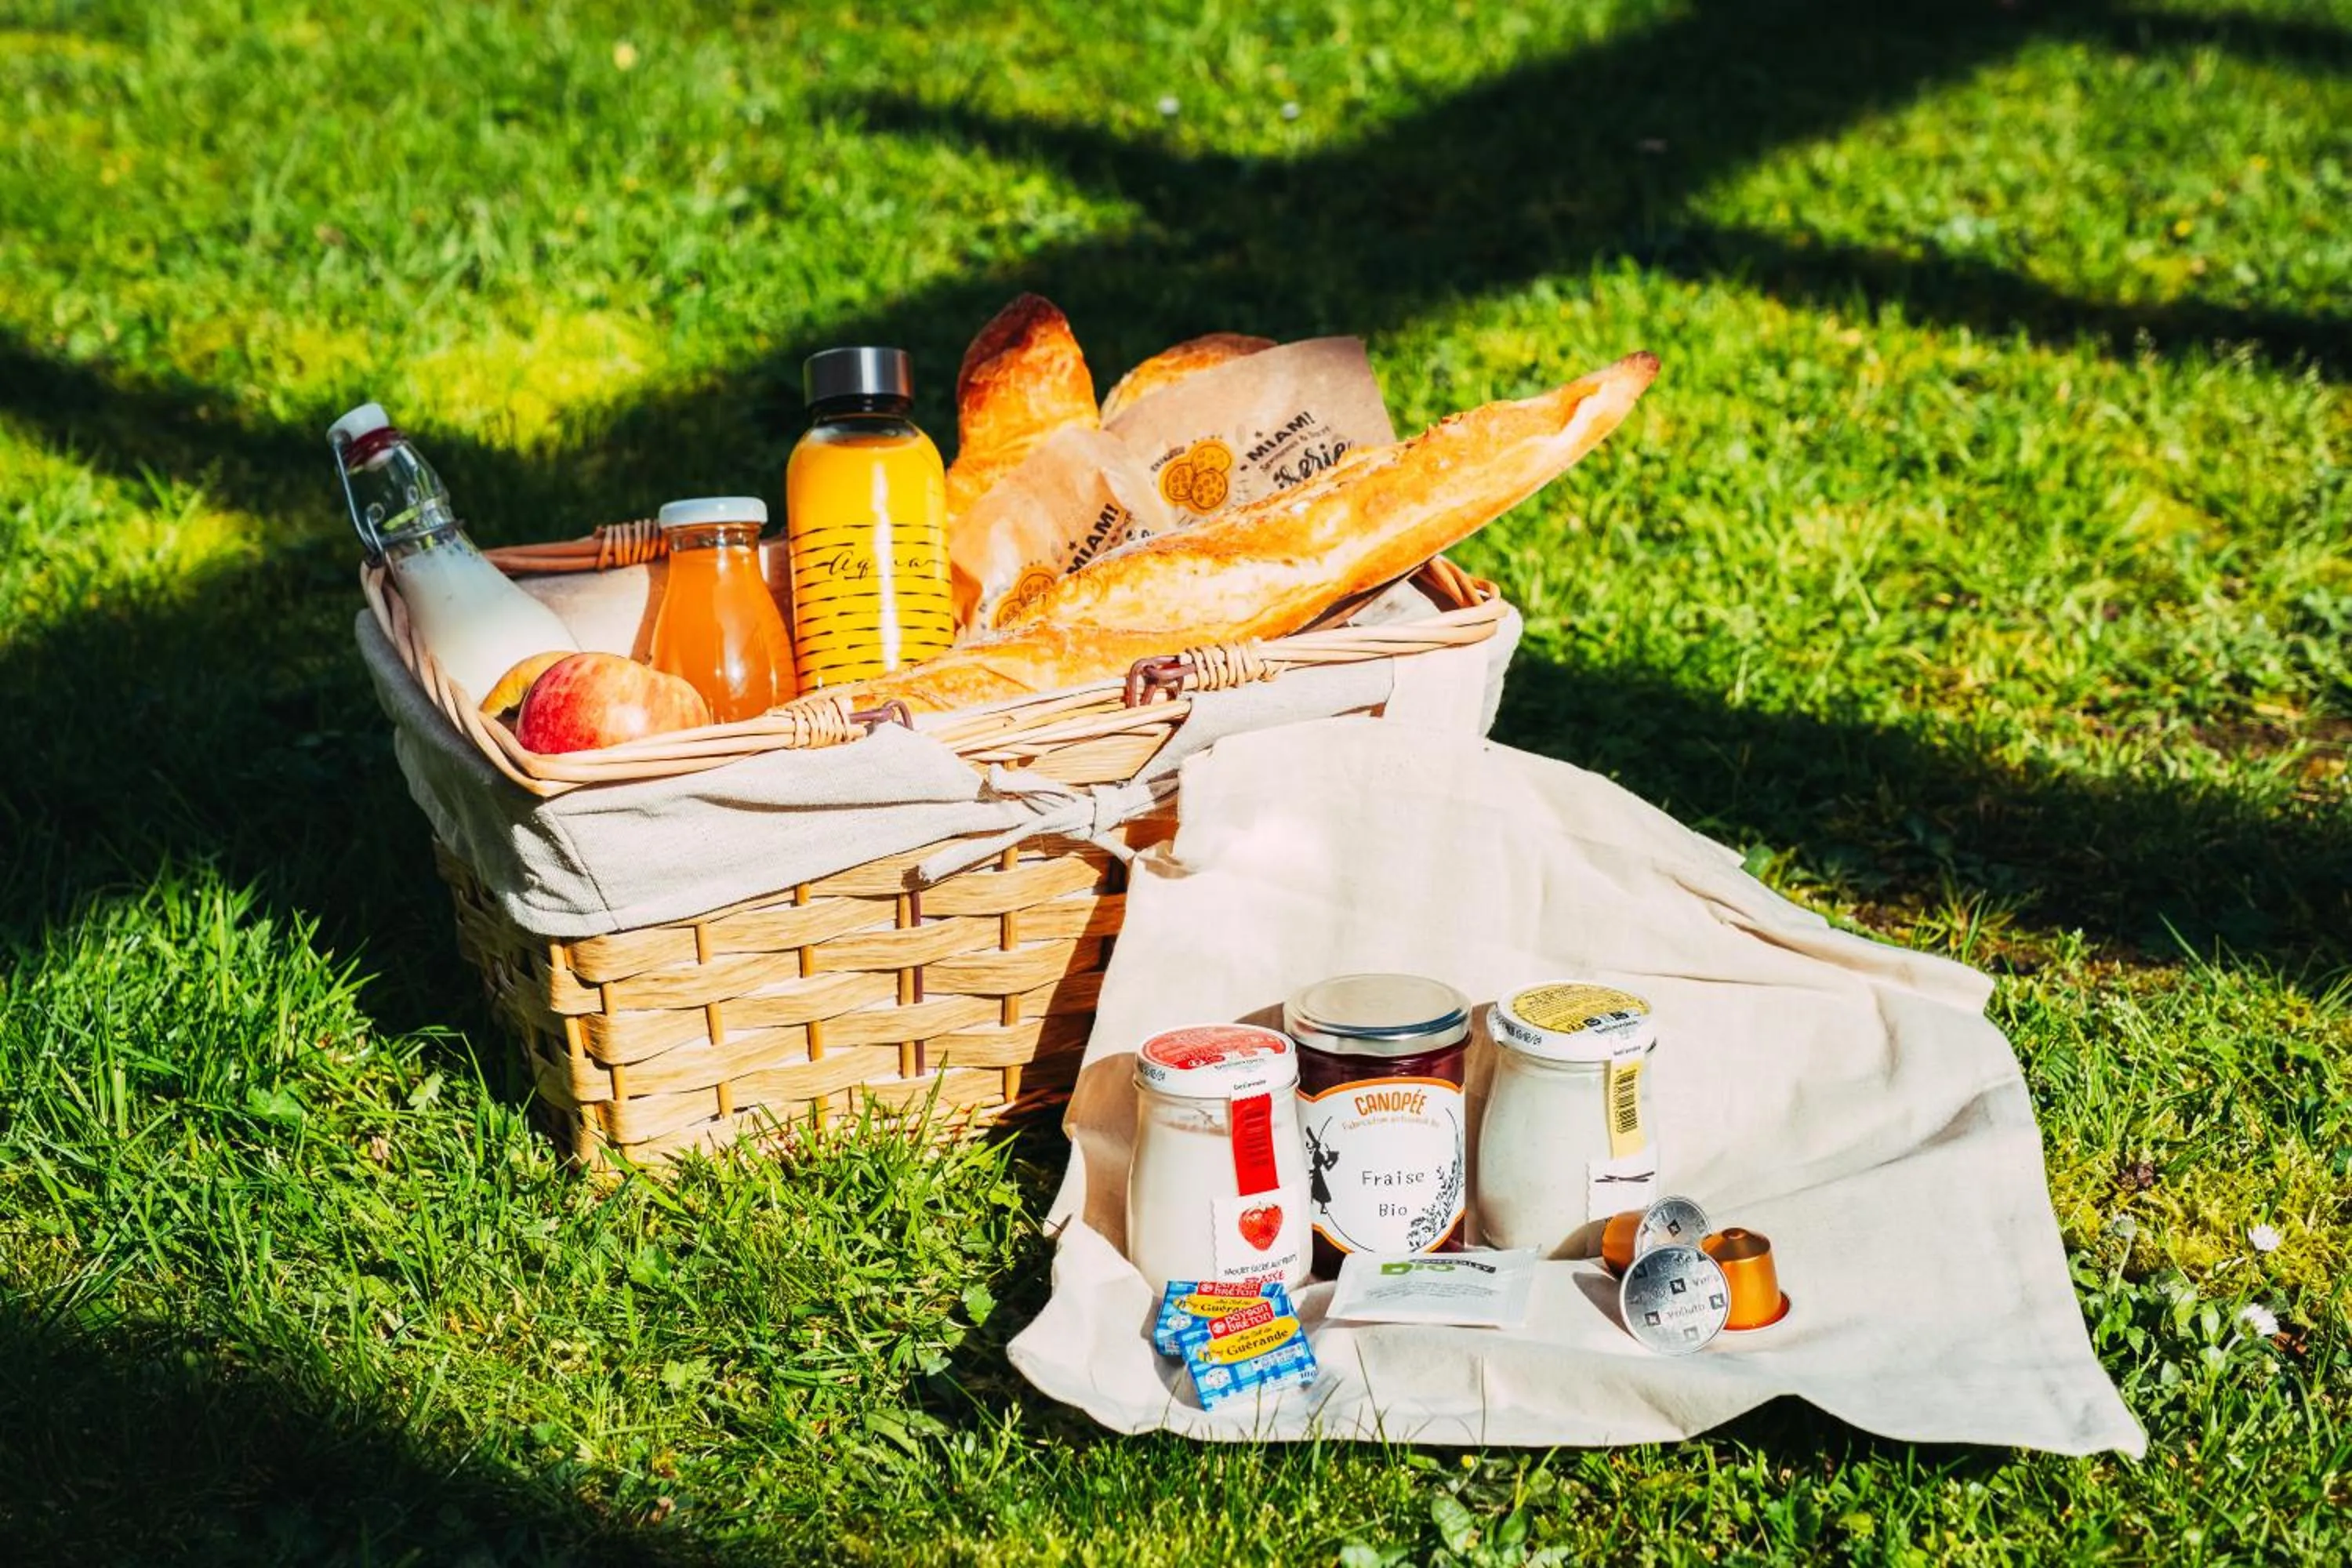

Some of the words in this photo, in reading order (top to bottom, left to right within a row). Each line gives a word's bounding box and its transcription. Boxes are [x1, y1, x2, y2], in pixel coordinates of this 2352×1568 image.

[1245, 410, 1316, 462] MIAM!
[1354, 1088, 1428, 1116] CANOPÉE
[1362, 1170, 1425, 1186] Fraise
[1378, 1203, 1408, 1217] Bio
[1225, 1304, 1269, 1324] paysan
[1226, 1329, 1289, 1356] Guérande
